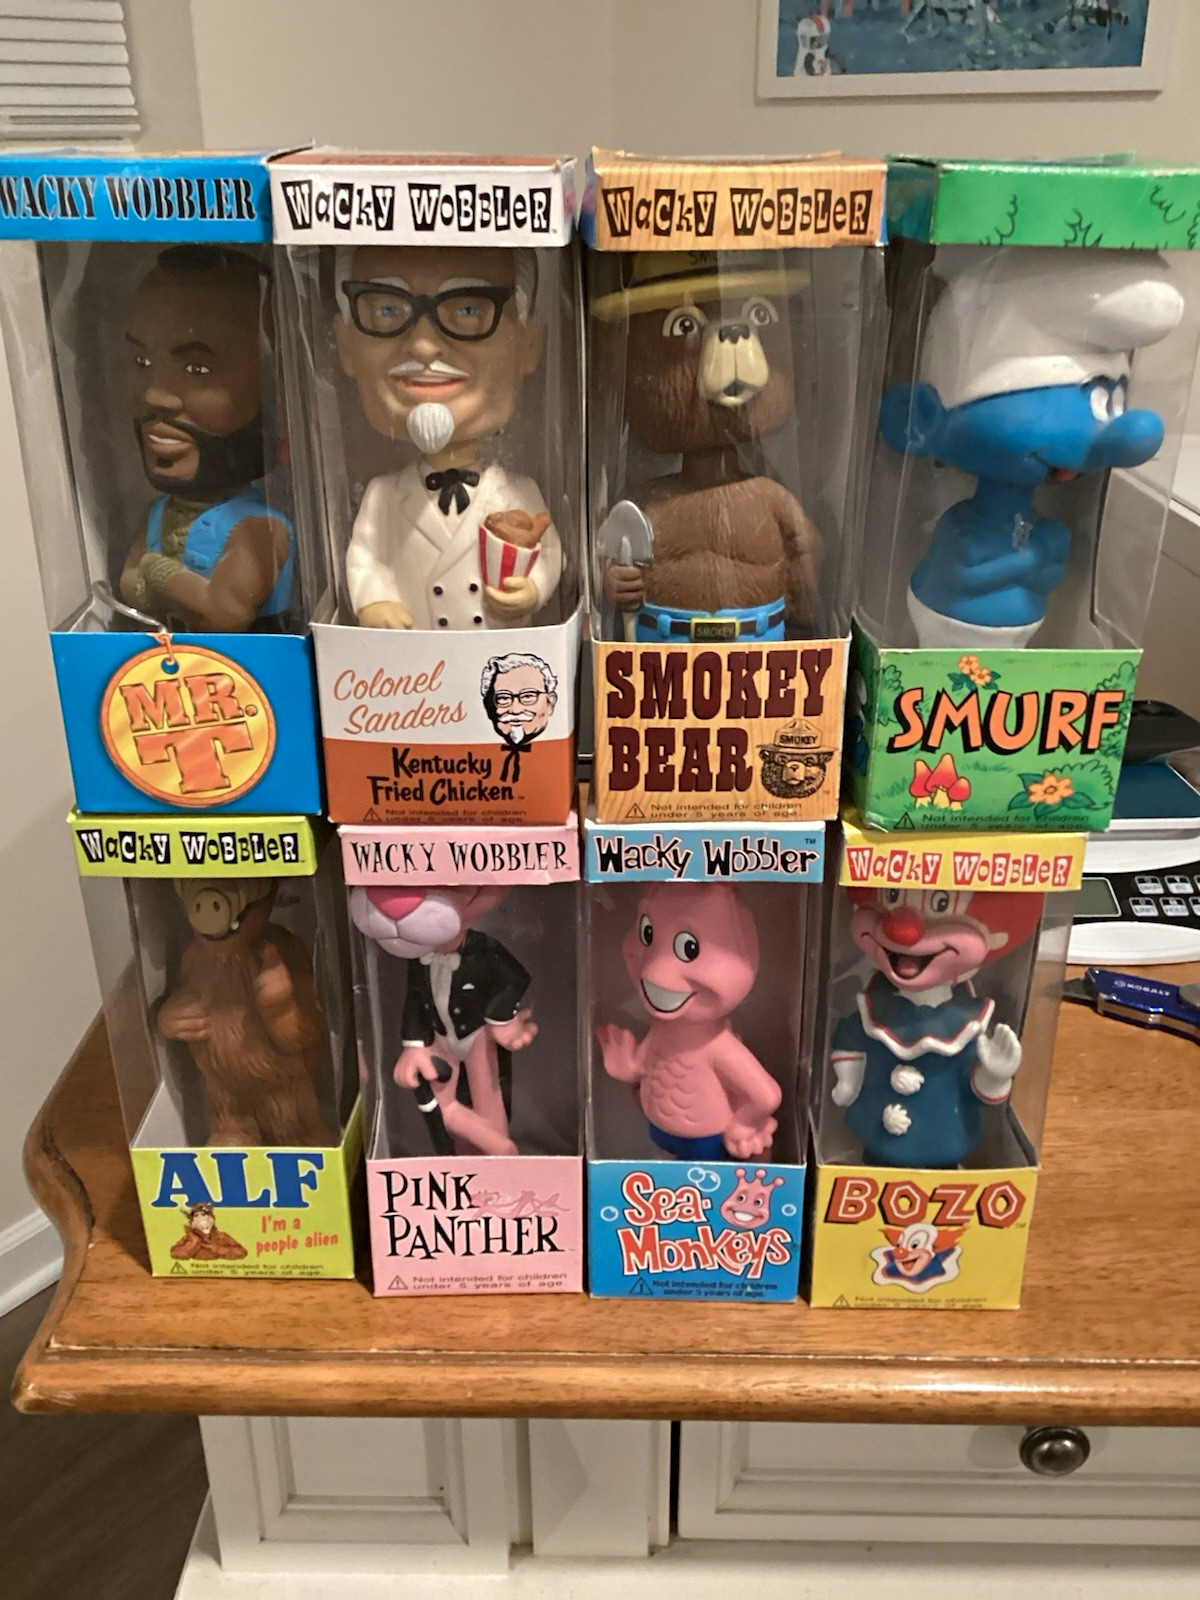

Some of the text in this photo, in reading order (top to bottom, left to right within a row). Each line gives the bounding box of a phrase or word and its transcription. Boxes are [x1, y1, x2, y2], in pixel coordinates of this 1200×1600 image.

[0, 175, 257, 222] WACKY WOBBLER
[333, 660, 446, 700] Colonel
[605, 648, 832, 720] SMOKEY
[120, 672, 258, 732] MR.
[343, 698, 468, 734] Sanders
[886, 687, 1125, 755] SMURF
[132, 720, 254, 794] T
[780, 734, 817, 745] SMOKEY
[392, 747, 492, 779] Kentucky
[608, 727, 753, 792] BEAR
[367, 775, 514, 805] Fried Chicken
[651, 803, 802, 811] Not intended for children
[386, 808, 406, 817] Not
[410, 809, 459, 817] intended
[711, 811, 746, 819] years
[922, 814, 946, 822] Not
[350, 841, 567, 873] WACKY WOBBLER
[594, 835, 692, 878] Wacky
[702, 836, 819, 877] Wobbler
[1127, 983, 1170, 996] KOBALT
[151, 1152, 324, 1208] ALF
[376, 1171, 482, 1214] PINK
[823, 1176, 1026, 1229] BOZO
[261, 1215, 301, 1233] I'm a
[380, 1214, 565, 1259] PANTHER
[256, 1232, 338, 1257] people alien
[616, 1225, 792, 1279] Monkeys
[663, 1288, 693, 1296] under
[704, 1289, 730, 1297] years
[672, 1280, 716, 1288] intended
[720, 1281, 733, 1289] for
[735, 1281, 777, 1290] children
